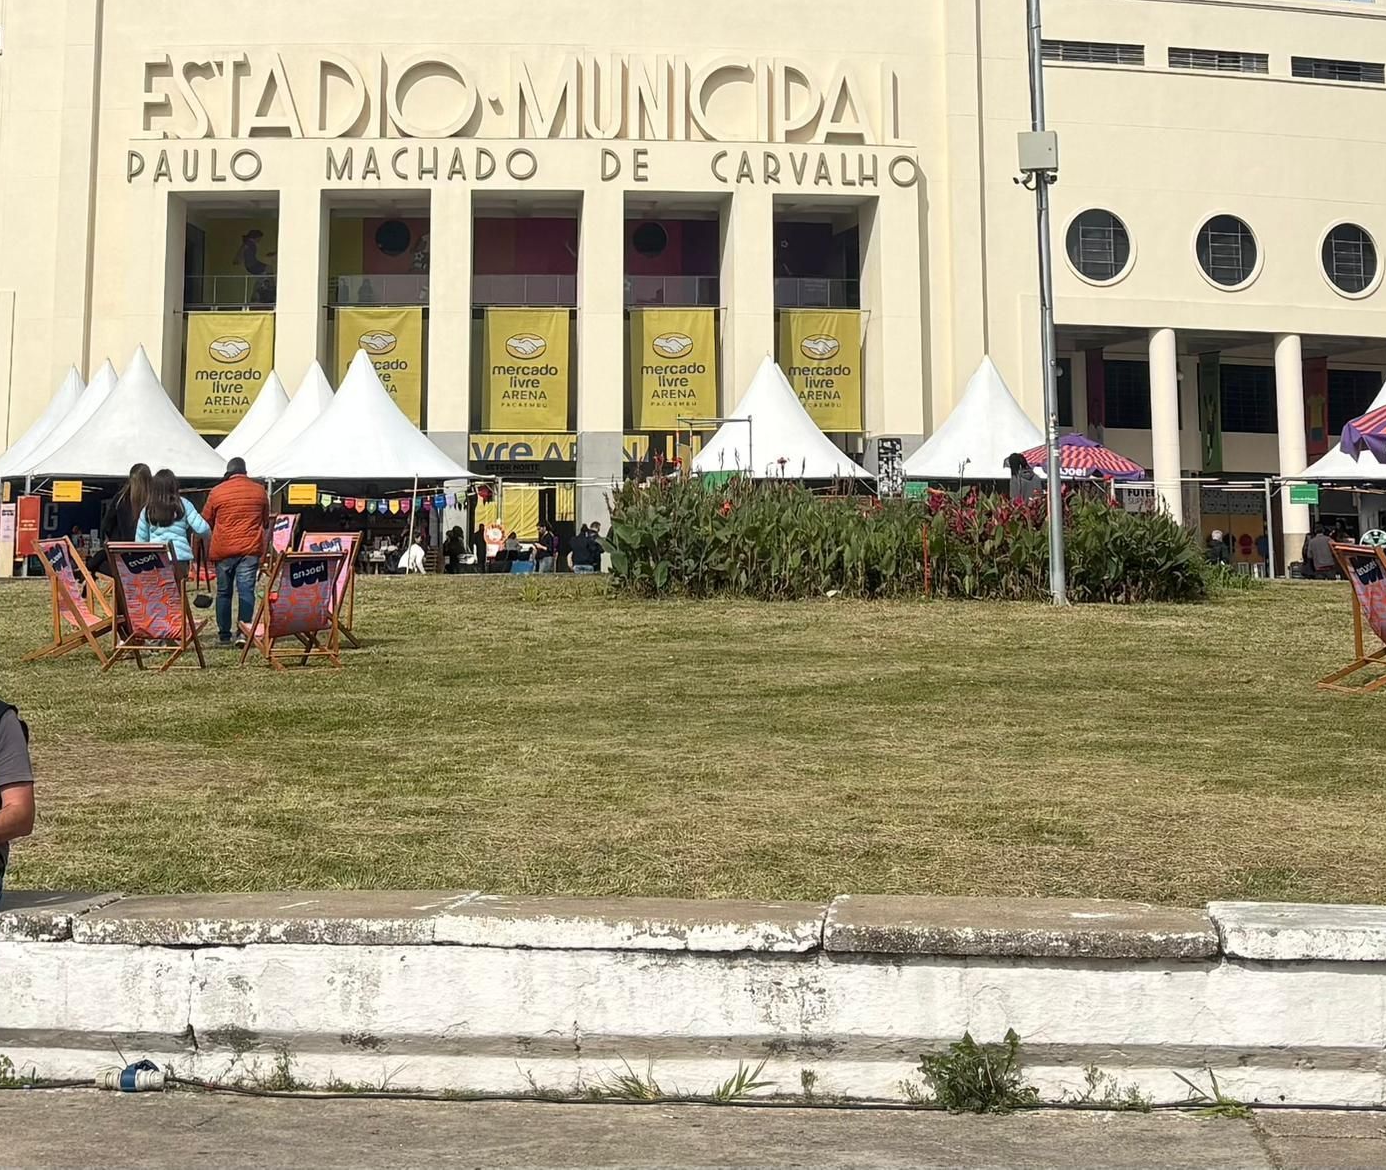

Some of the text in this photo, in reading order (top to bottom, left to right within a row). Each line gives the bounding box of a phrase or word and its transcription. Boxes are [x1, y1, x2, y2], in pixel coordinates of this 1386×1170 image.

[126, 146, 920, 188] PAULO MACHADO DE CARVALHO
[195, 368, 262, 381] mercado
[492, 363, 559, 376] mercado
[641, 362, 706, 375] mercado
[788, 364, 852, 376] mercado
[212, 381, 244, 394] livre
[509, 376, 541, 389] livre
[658, 374, 690, 388] livre
[805, 376, 835, 389] livre
[501, 391, 548, 400] ARENA
[651, 390, 697, 399] ARENA
[798, 390, 841, 400] ARENA
[204, 396, 250, 407] ARENA
[1059, 467, 1087, 477] joei
